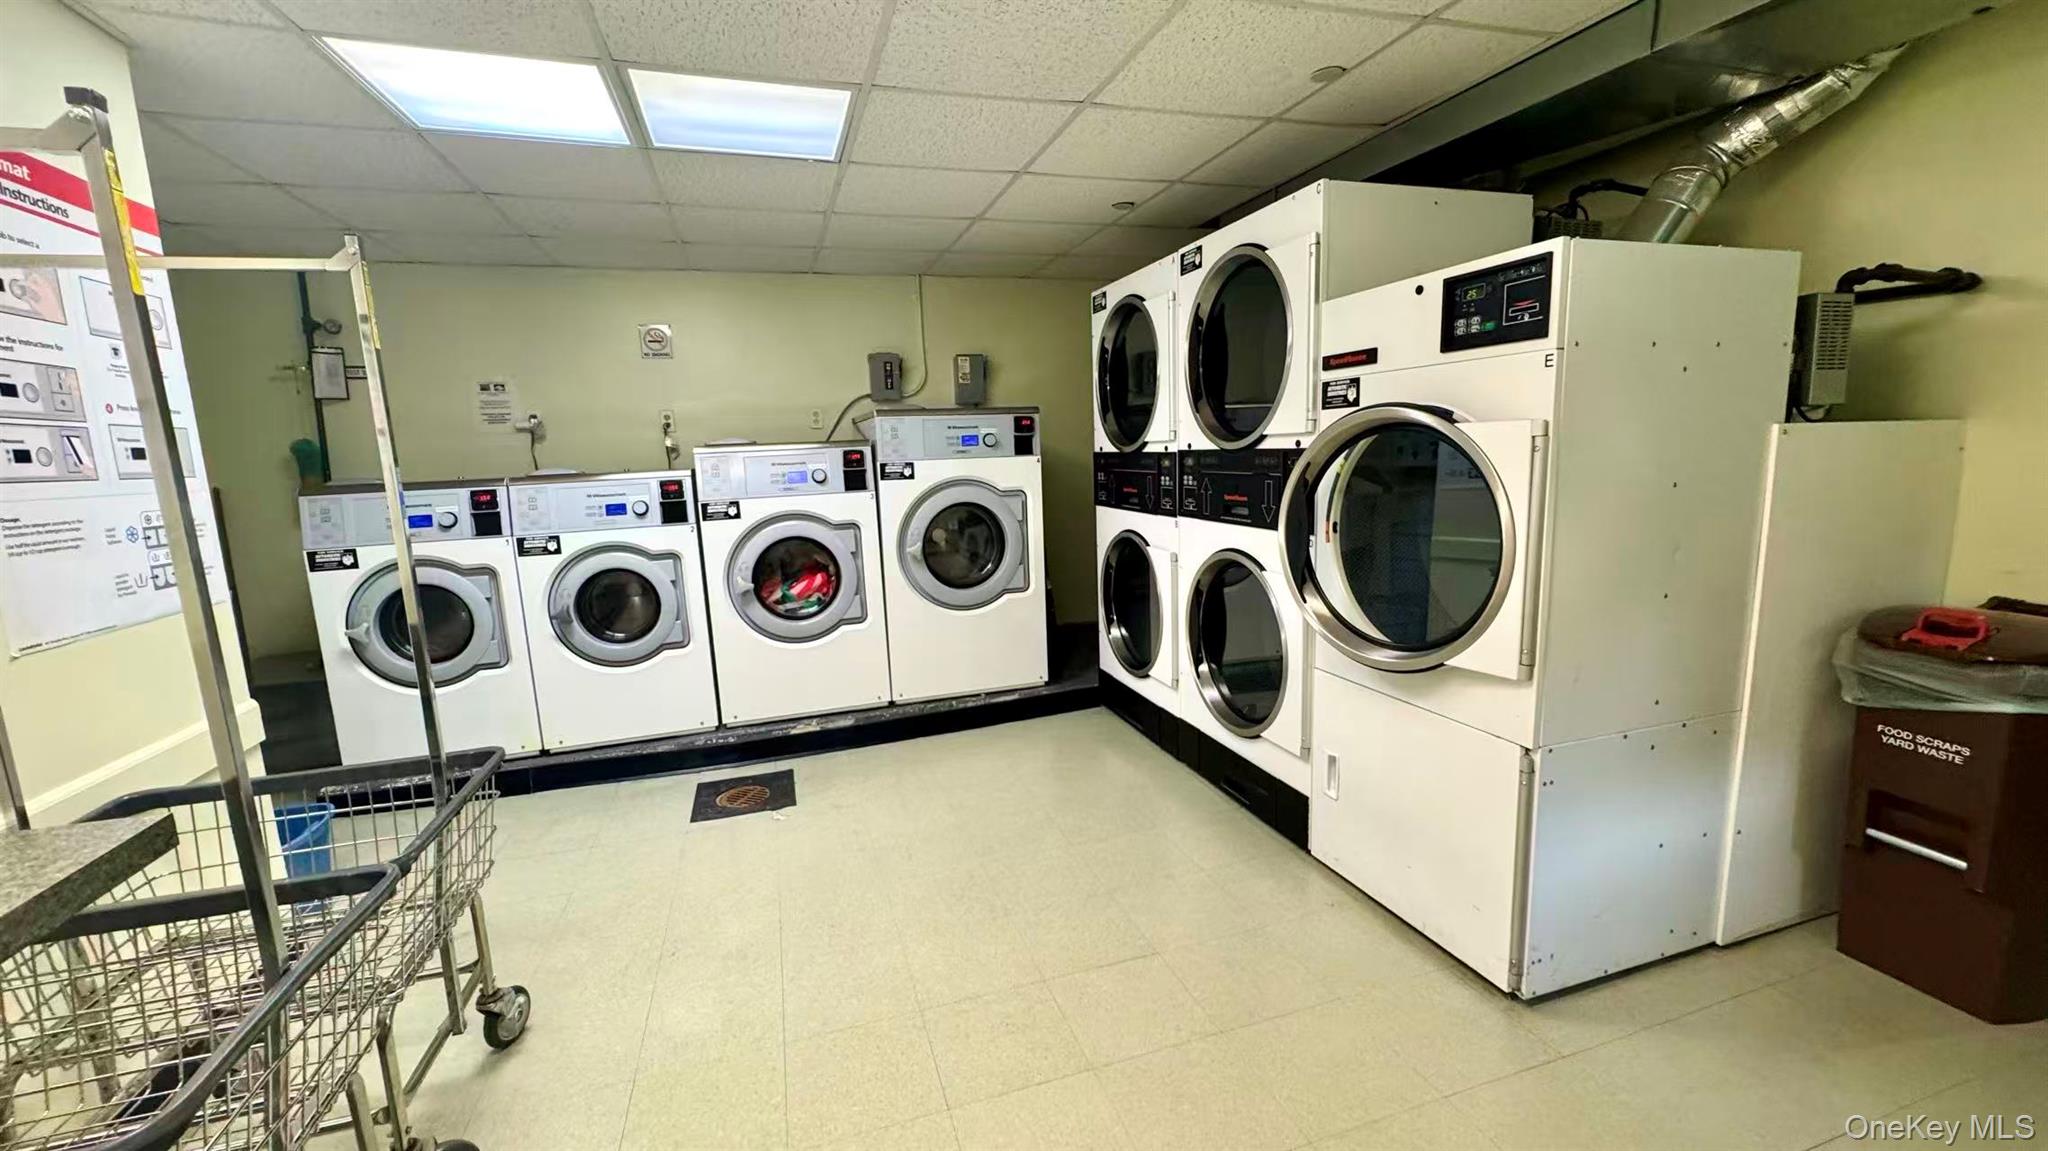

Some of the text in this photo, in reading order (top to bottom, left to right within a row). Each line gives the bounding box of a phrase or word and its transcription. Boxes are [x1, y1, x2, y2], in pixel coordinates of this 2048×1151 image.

[1545, 353, 1555, 368] E
[1877, 724, 1971, 756] FOOD SCRAPS
[1881, 734, 1965, 765] YARD WASTE
